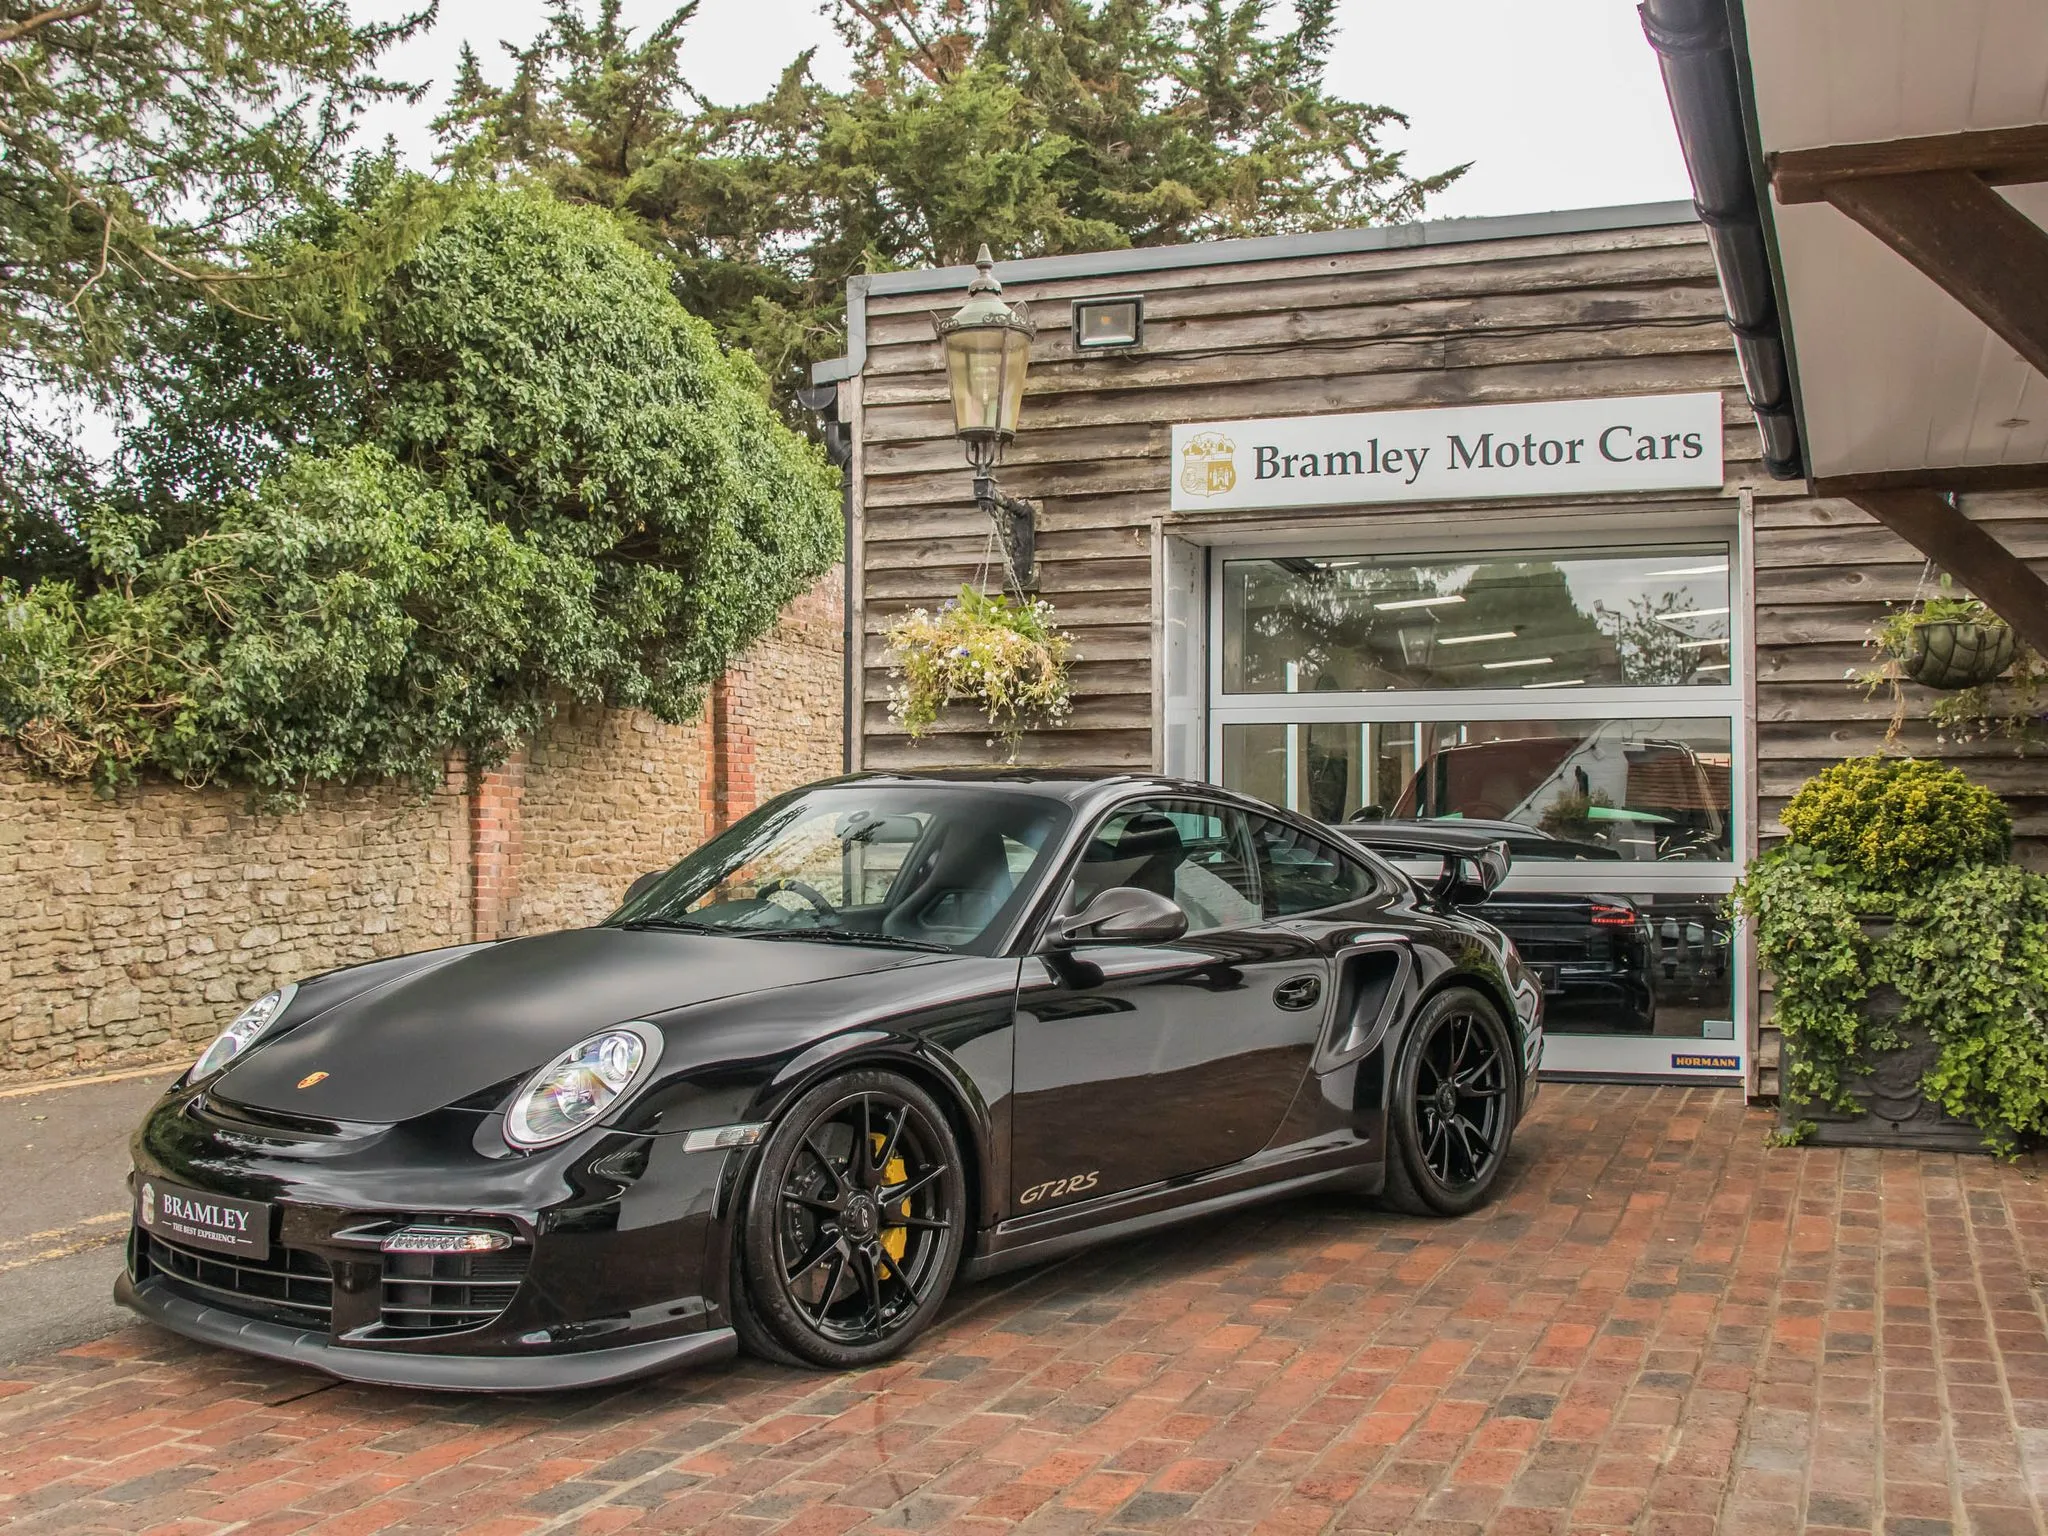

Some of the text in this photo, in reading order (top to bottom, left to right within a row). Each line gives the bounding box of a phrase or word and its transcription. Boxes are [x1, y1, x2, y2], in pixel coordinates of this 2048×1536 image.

[1252, 425, 1703, 484] Bramley Motor Cars
[163, 1194, 249, 1231] BRAMLEY
[172, 1222, 236, 1244] THE BEST EXPERIENCE
